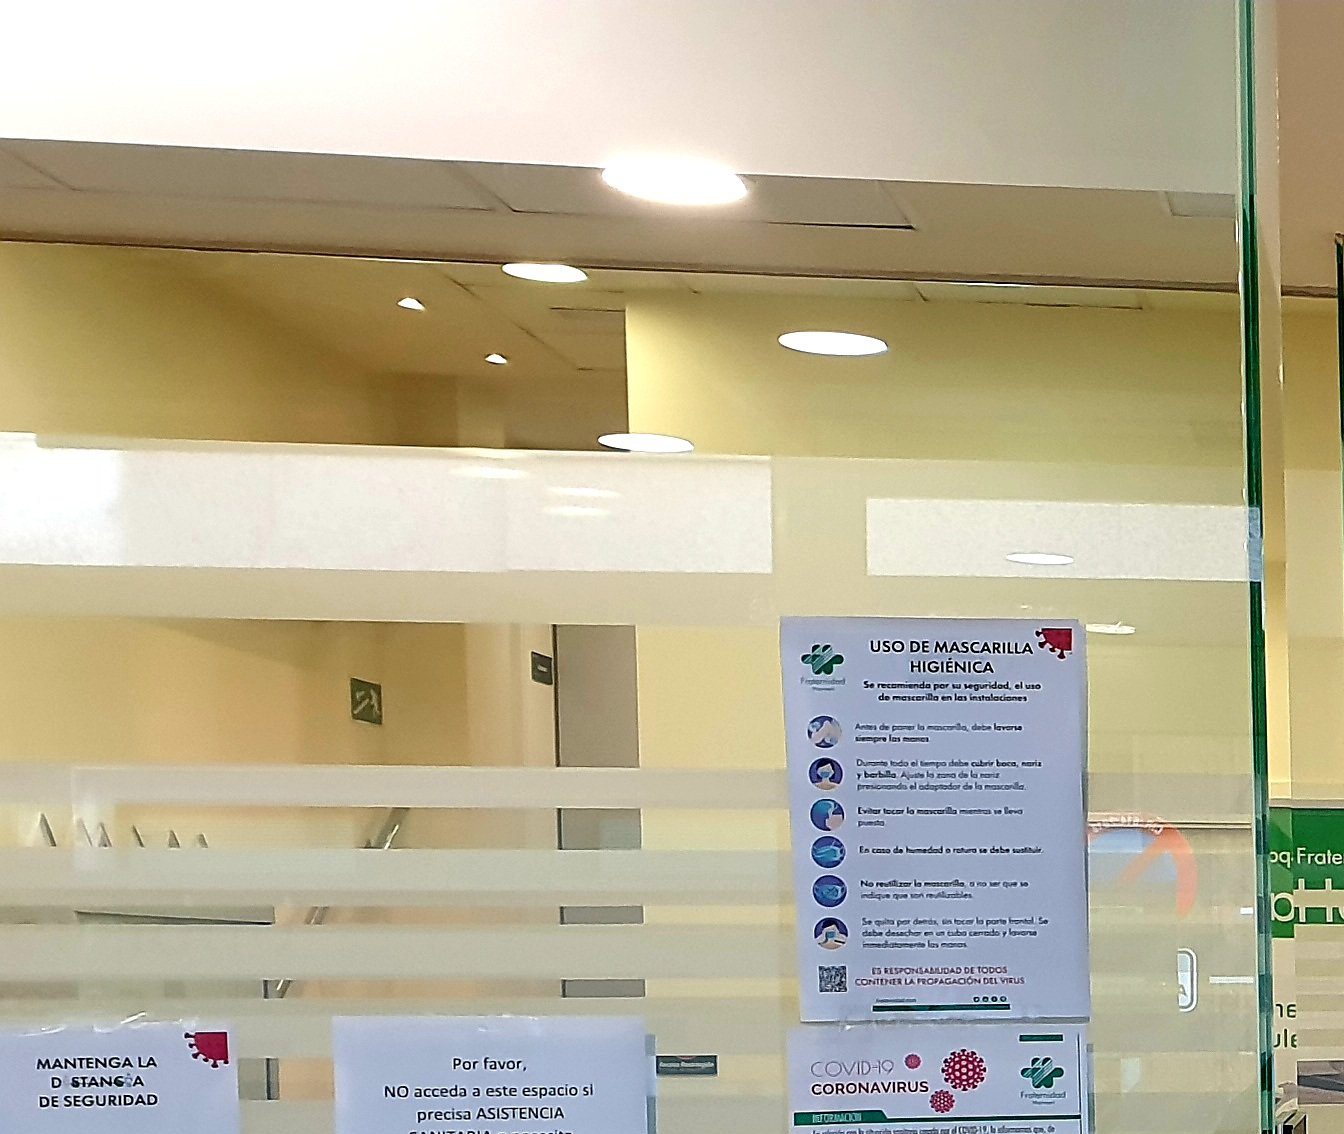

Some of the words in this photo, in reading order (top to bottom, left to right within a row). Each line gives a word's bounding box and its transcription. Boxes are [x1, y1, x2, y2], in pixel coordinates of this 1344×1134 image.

[870, 640, 905, 652] USO
[910, 641, 930, 653] DE
[934, 641, 1033, 654] MASCARILLA
[911, 657, 994, 673] HIGIÉNICA
[863, 681, 875, 689] Se
[877, 681, 931, 689] recomienda
[964, 681, 1011, 691] seguridad,
[1014, 681, 1023, 689] el
[878, 693, 890, 701] de
[892, 693, 939, 701] mascarilla
[954, 693, 967, 701] las
[969, 693, 1027, 702] instalaciones
[37, 1057, 134, 1070] MANTENGA
[138, 1056, 157, 1068] LA
[453, 1058, 479, 1070] Por
[484, 1057, 526, 1071] favor,
[811, 1059, 894, 1077] COVID-19
[385, 1086, 409, 1098] NO
[414, 1085, 467, 1097] acceda
[472, 1088, 480, 1097] a
[486, 1086, 517, 1097] este
[522, 1084, 578, 1099] espacio
[583, 1084, 593, 1096] si
[811, 1081, 929, 1095] CORONAVIRUS
[39, 1096, 59, 1108] DE
[64, 1094, 158, 1107] SEGURIDAD
[417, 1108, 471, 1123] precisa
[476, 1107, 564, 1120] ASISTENCIA
